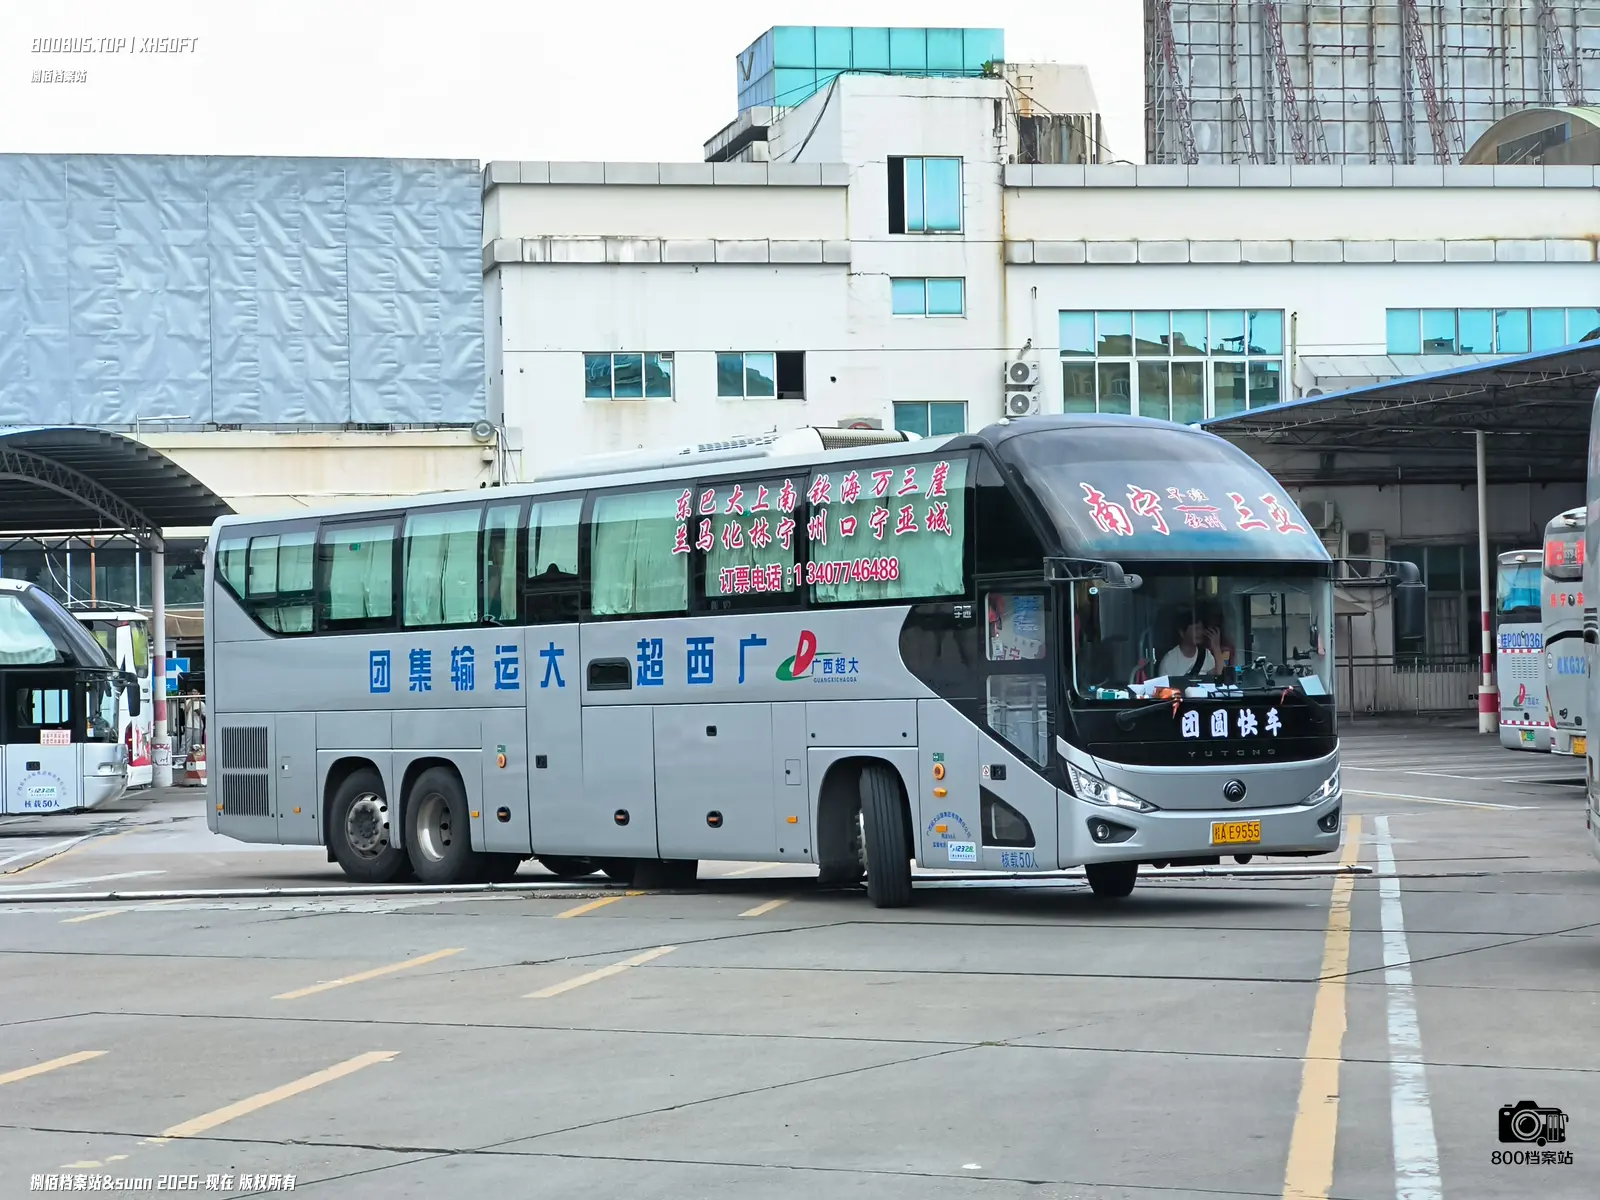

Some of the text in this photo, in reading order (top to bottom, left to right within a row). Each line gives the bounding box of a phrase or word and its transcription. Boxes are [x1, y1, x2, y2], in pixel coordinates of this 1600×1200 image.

[1079, 482, 1170, 536] 南宁
[811, 656, 859, 675] 广西超大
[1181, 707, 1283, 738] 团圆快车
[1188, 748, 1276, 758] YUTONG
[24, 799, 60, 808] 核载50人
[1001, 851, 1040, 868] 核载50人
